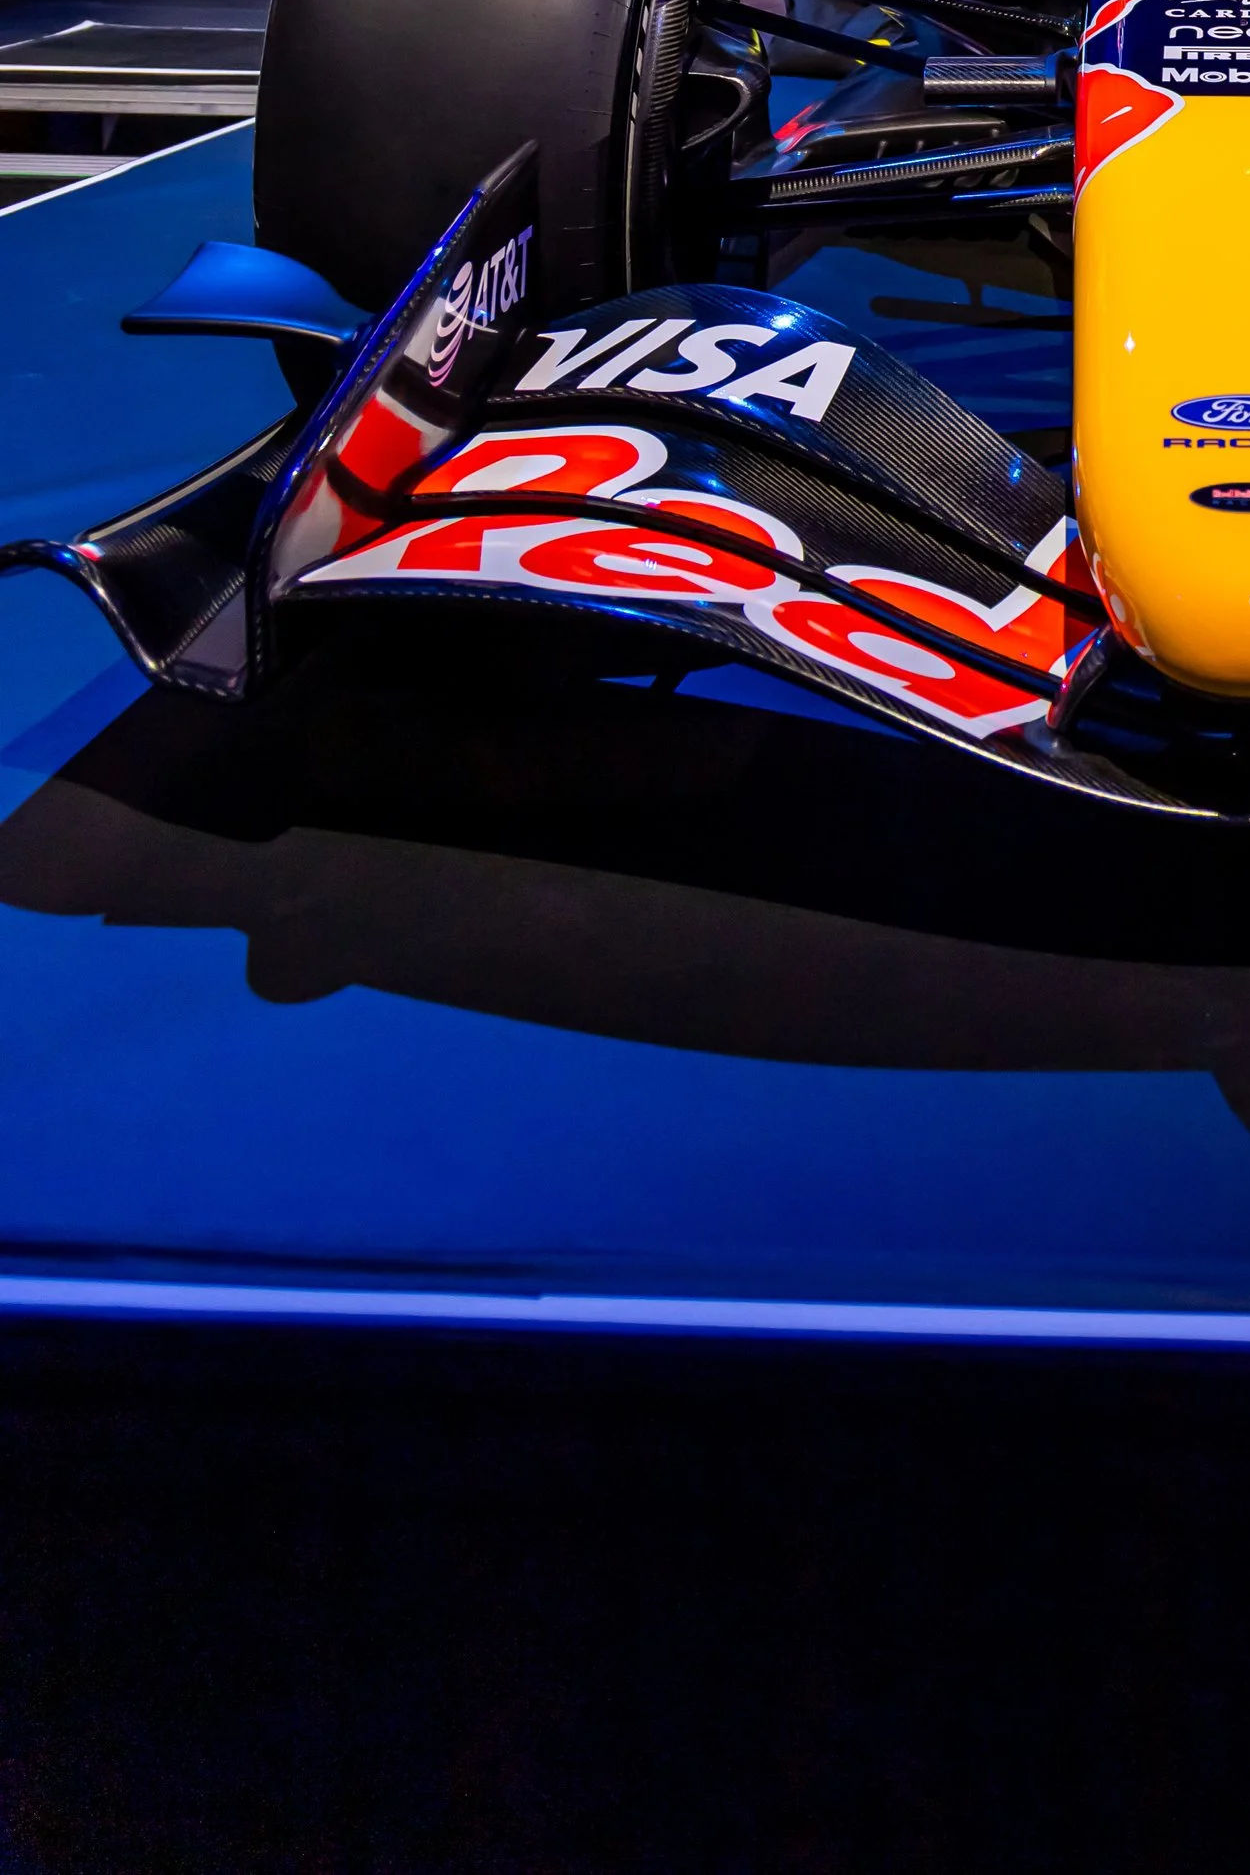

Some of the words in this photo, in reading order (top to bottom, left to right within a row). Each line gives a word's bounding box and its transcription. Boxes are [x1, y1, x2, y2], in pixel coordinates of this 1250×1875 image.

[467, 225, 533, 341] AT&T
[516, 318, 857, 423] VISA
[300, 425, 1090, 739] Red
